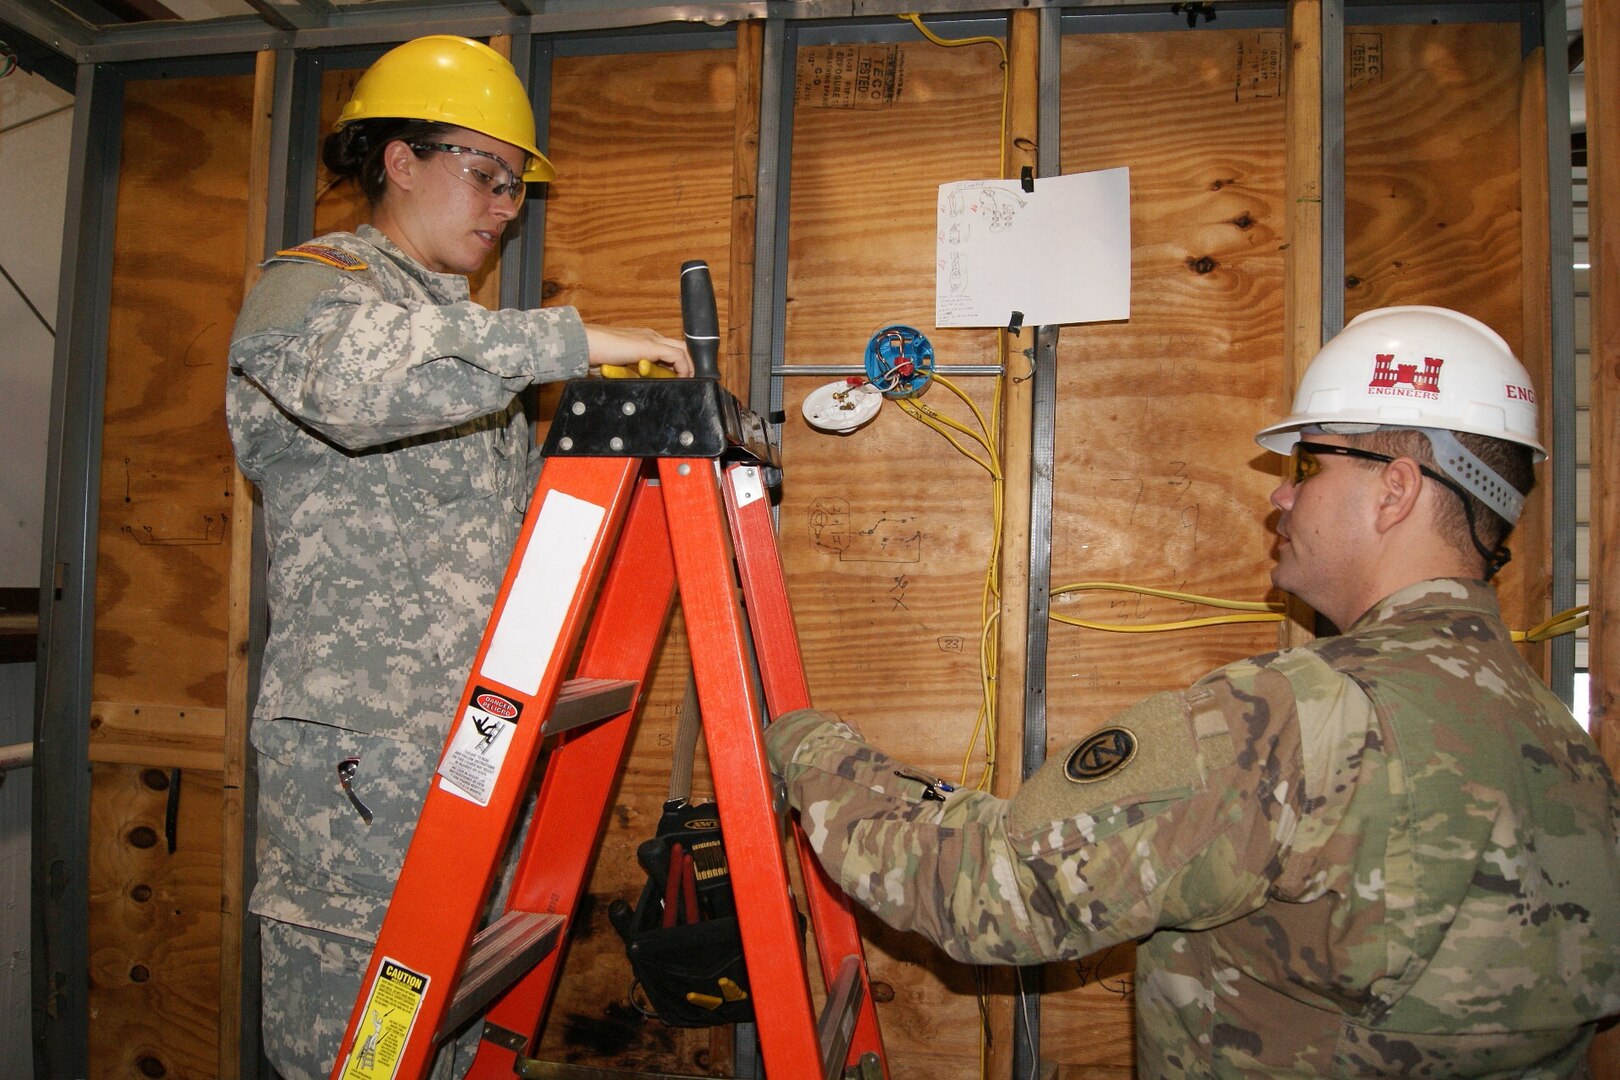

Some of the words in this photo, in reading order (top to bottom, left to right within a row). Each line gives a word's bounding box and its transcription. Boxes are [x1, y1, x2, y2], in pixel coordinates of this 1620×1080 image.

[833, 52, 844, 98] EXPOSURE
[871, 58, 884, 99] TECO
[1368, 387, 1439, 400] ENGINEERS
[1505, 385, 1537, 404] ENG
[482, 701, 511, 716] PELIGRO
[486, 696, 512, 711] DANGER
[386, 965, 423, 989] CAUTION
